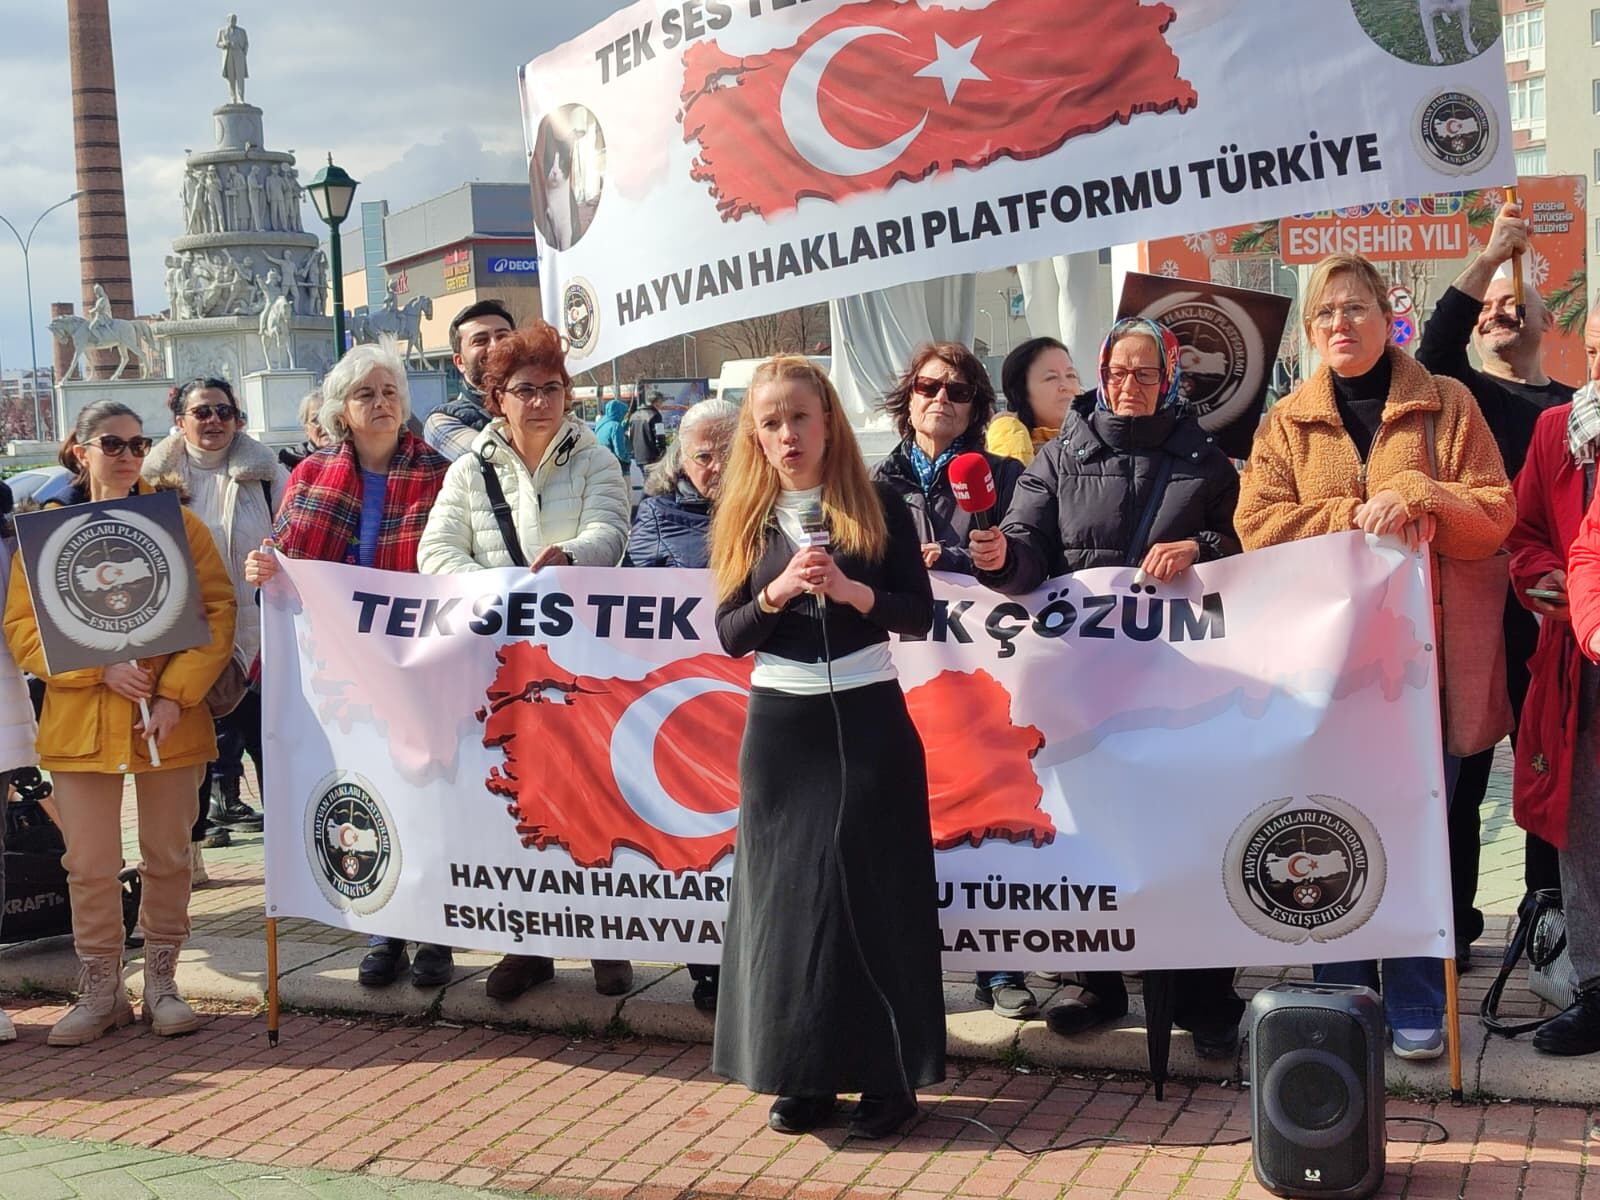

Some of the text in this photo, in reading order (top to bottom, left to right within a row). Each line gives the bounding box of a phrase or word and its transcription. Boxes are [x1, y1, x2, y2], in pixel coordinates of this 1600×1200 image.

[595, 0, 732, 84] TEK SES
[616, 255, 743, 326] HAYVAN
[748, 216, 915, 287] HAKLARI
[921, 165, 1182, 248] PLATFORMU
[1188, 130, 1382, 199] TÜRKİYE
[1418, 223, 1461, 251] YILI
[57, 524, 168, 592] HAYVAN HAKLARI PLATFORMU
[89, 606, 158, 633] ESKİŞEHİR
[352, 591, 464, 638] TEK
[468, 591, 576, 638] SES
[588, 595, 702, 640] TEK
[985, 583, 1225, 658] ÇÖZÜM
[314, 786, 390, 853] HAYVAN HAKLARI PLATFORMU
[1244, 812, 1366, 879] HAYVAN HAKLARI PLATFORMU
[332, 875, 371, 897] TÜRKİYE
[450, 863, 584, 895] HAYVAN
[961, 874, 1118, 911] TÜRKİYE
[444, 904, 725, 944] ESKİŞEHİR HAYVA
[1270, 905, 1348, 927] ESKİŞEHİR
[937, 928, 1136, 953] LATFORMU
